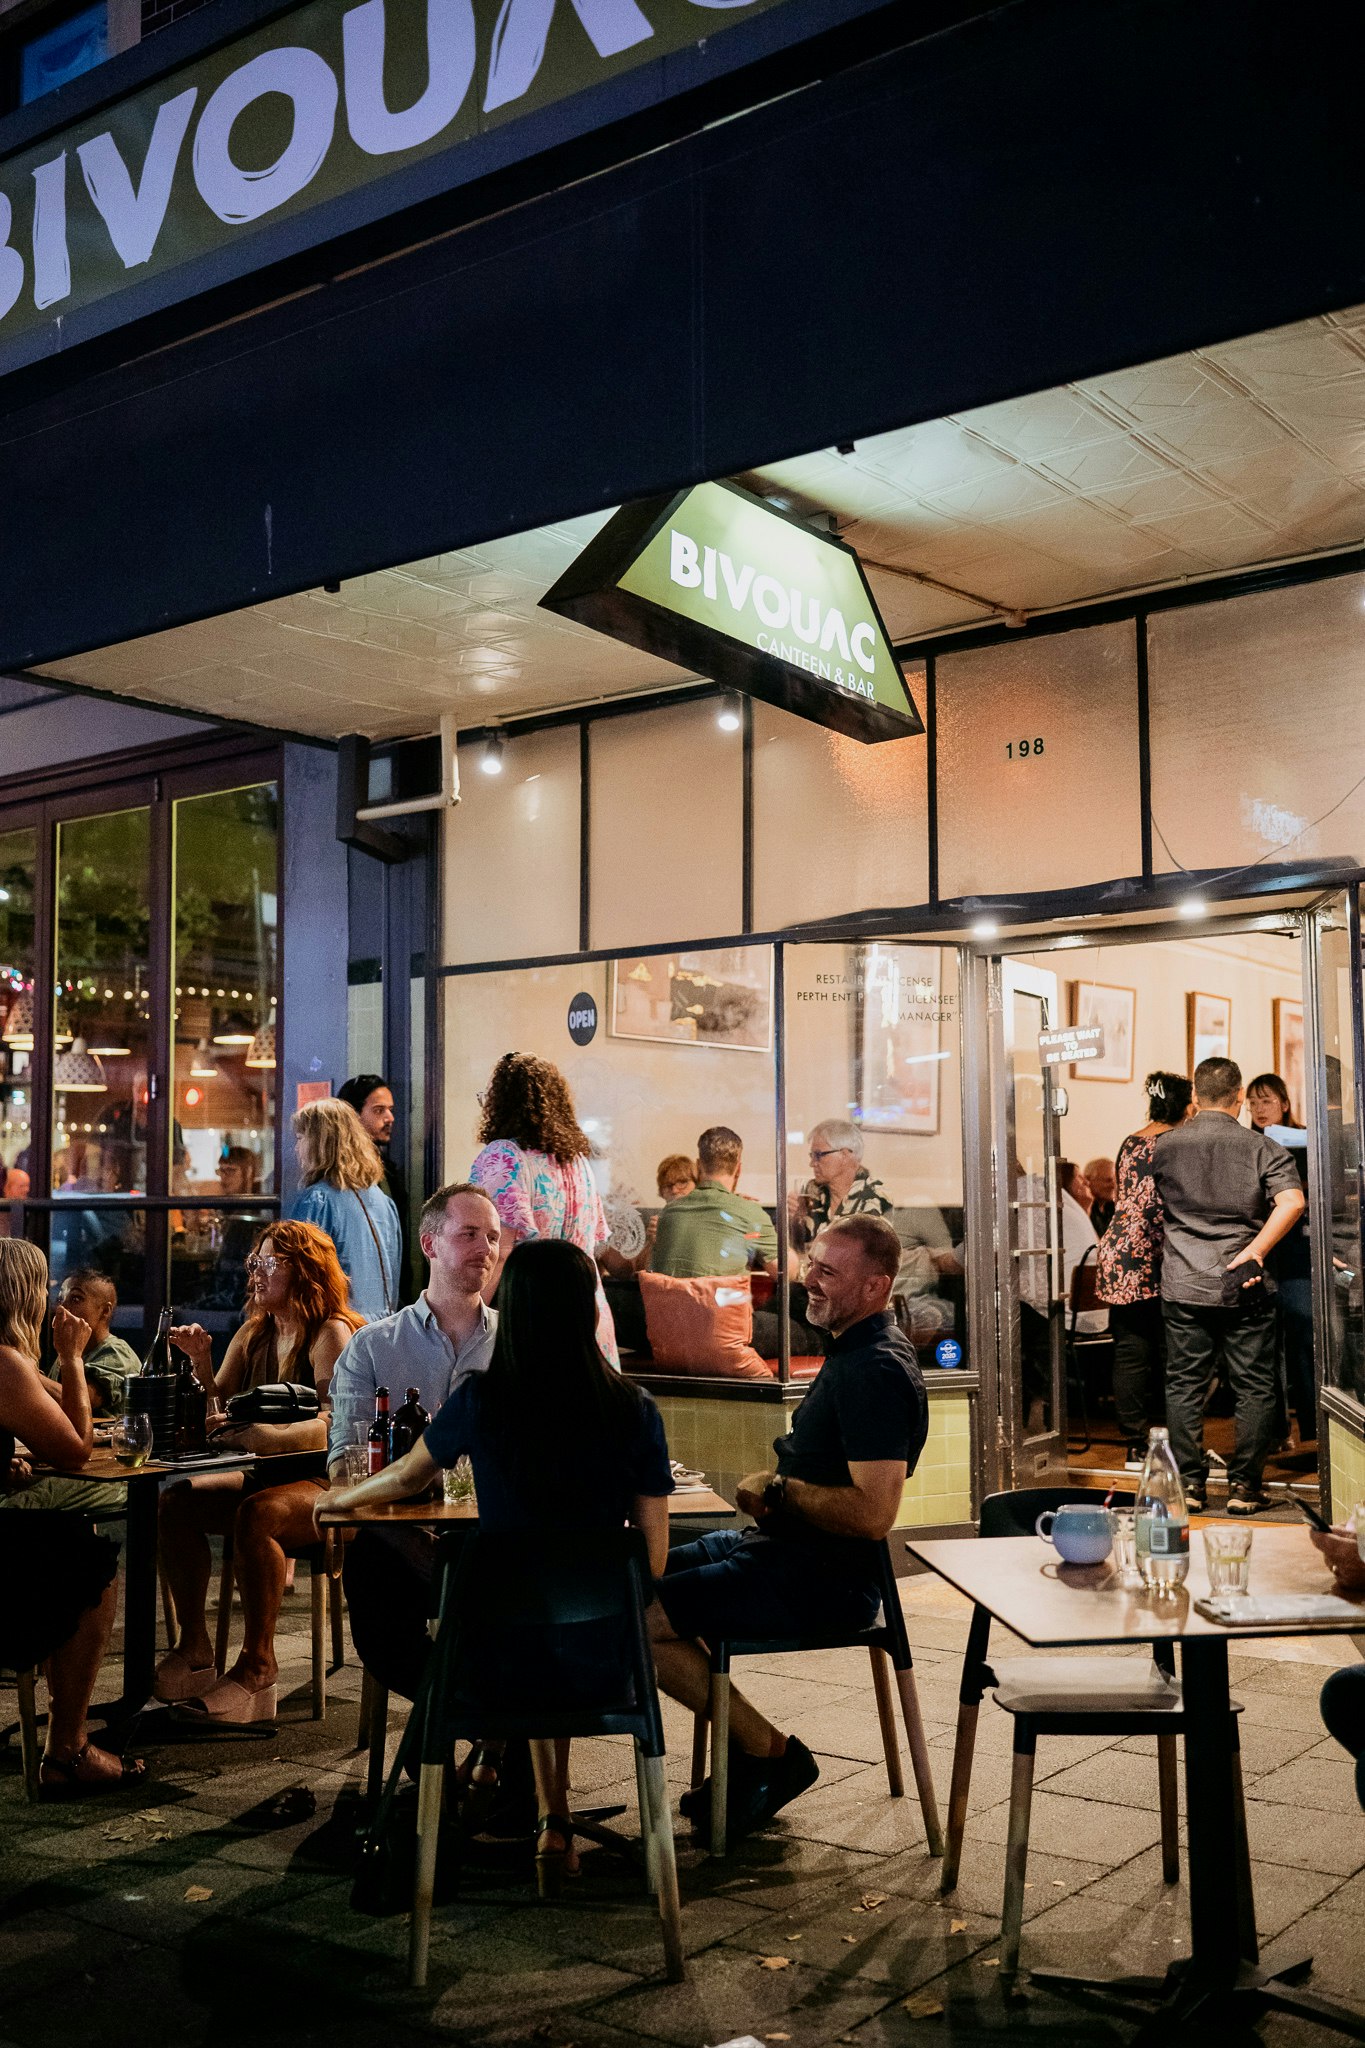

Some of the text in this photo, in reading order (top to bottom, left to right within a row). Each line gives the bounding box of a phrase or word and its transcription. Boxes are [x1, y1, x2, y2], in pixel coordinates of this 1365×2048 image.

[0, 0, 757, 317] IVOUA
[671, 529, 876, 674] BIVOUAC
[756, 632, 876, 701] CANTEEN & BAR
[1006, 738, 1044, 759] 198
[797, 992, 828, 1002] PERTH
[569, 1009, 595, 1030] OPEN
[1039, 1028, 1101, 1046] PLEASE WAIT
[1064, 1041, 1079, 1051] TO
